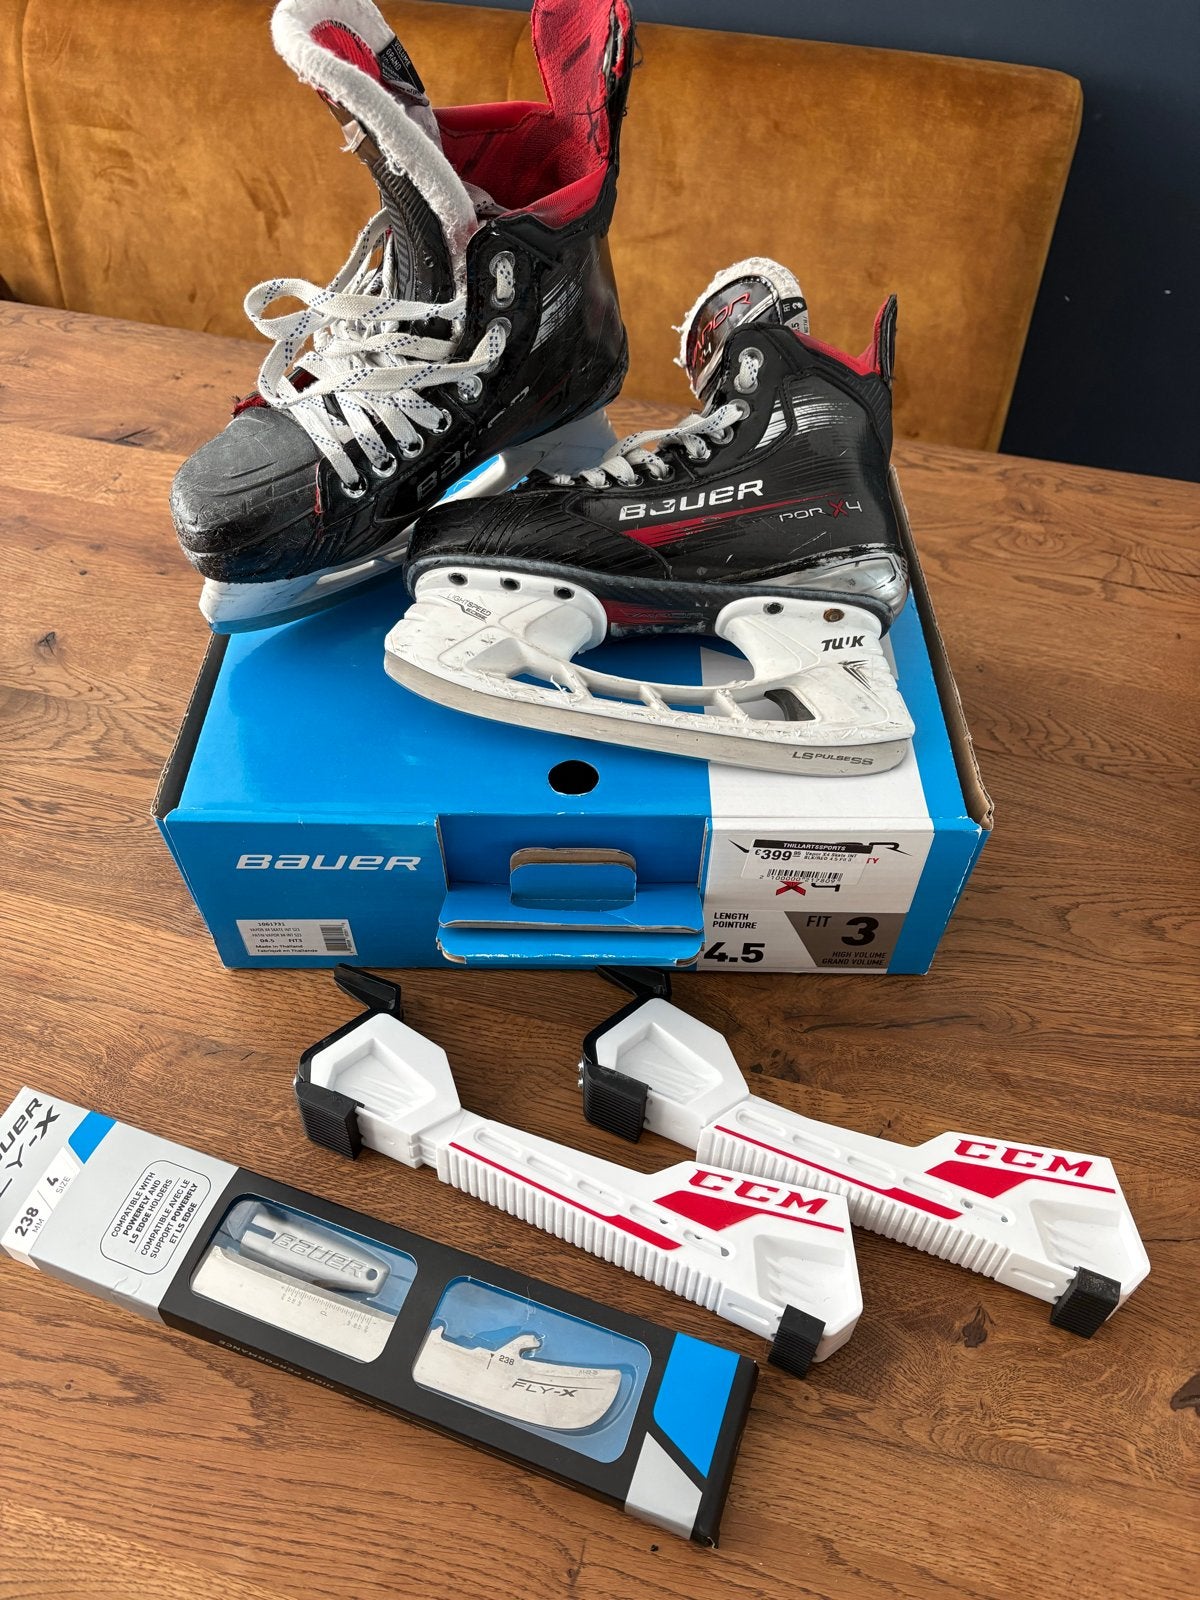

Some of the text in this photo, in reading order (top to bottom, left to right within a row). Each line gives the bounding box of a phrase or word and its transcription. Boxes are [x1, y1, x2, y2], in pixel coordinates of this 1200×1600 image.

[385, 48, 402, 71] GRAND
[446, 593, 492, 617] LIGHTSPEED
[235, 854, 422, 871] BAUER
[712, 920, 758, 930] POINTURE
[714, 912, 750, 921] LENGTH
[806, 915, 832, 928] FIT
[841, 916, 880, 946] 3
[703, 941, 766, 963] 4.5
[854, 951, 887, 959] VOLUME
[953, 1138, 1094, 1179] CCM
[46, 1177, 59, 1187] 4
[55, 1176, 71, 1194] SIZE
[688, 1168, 829, 1215] CCM
[110, 1172, 155, 1238] COMPATIBLE WITH
[122, 1179, 161, 1236] POWERFLY AND
[129, 1178, 173, 1244] LS EDGE HOLDERS
[14, 1206, 39, 1237] 238
[32, 1218, 45, 1234] MM
[140, 1179, 190, 1256] COMPATIBLE AVEC LE
[149, 1183, 198, 1259] SUPPORT POWERFLY
[169, 1202, 198, 1244] ET LS EDGE
[271, 1231, 368, 1280] BAUER
[217, 1339, 303, 1375] PERFORMANCE
[498, 1353, 515, 1366] 238
[511, 1380, 578, 1399] FLY-X
